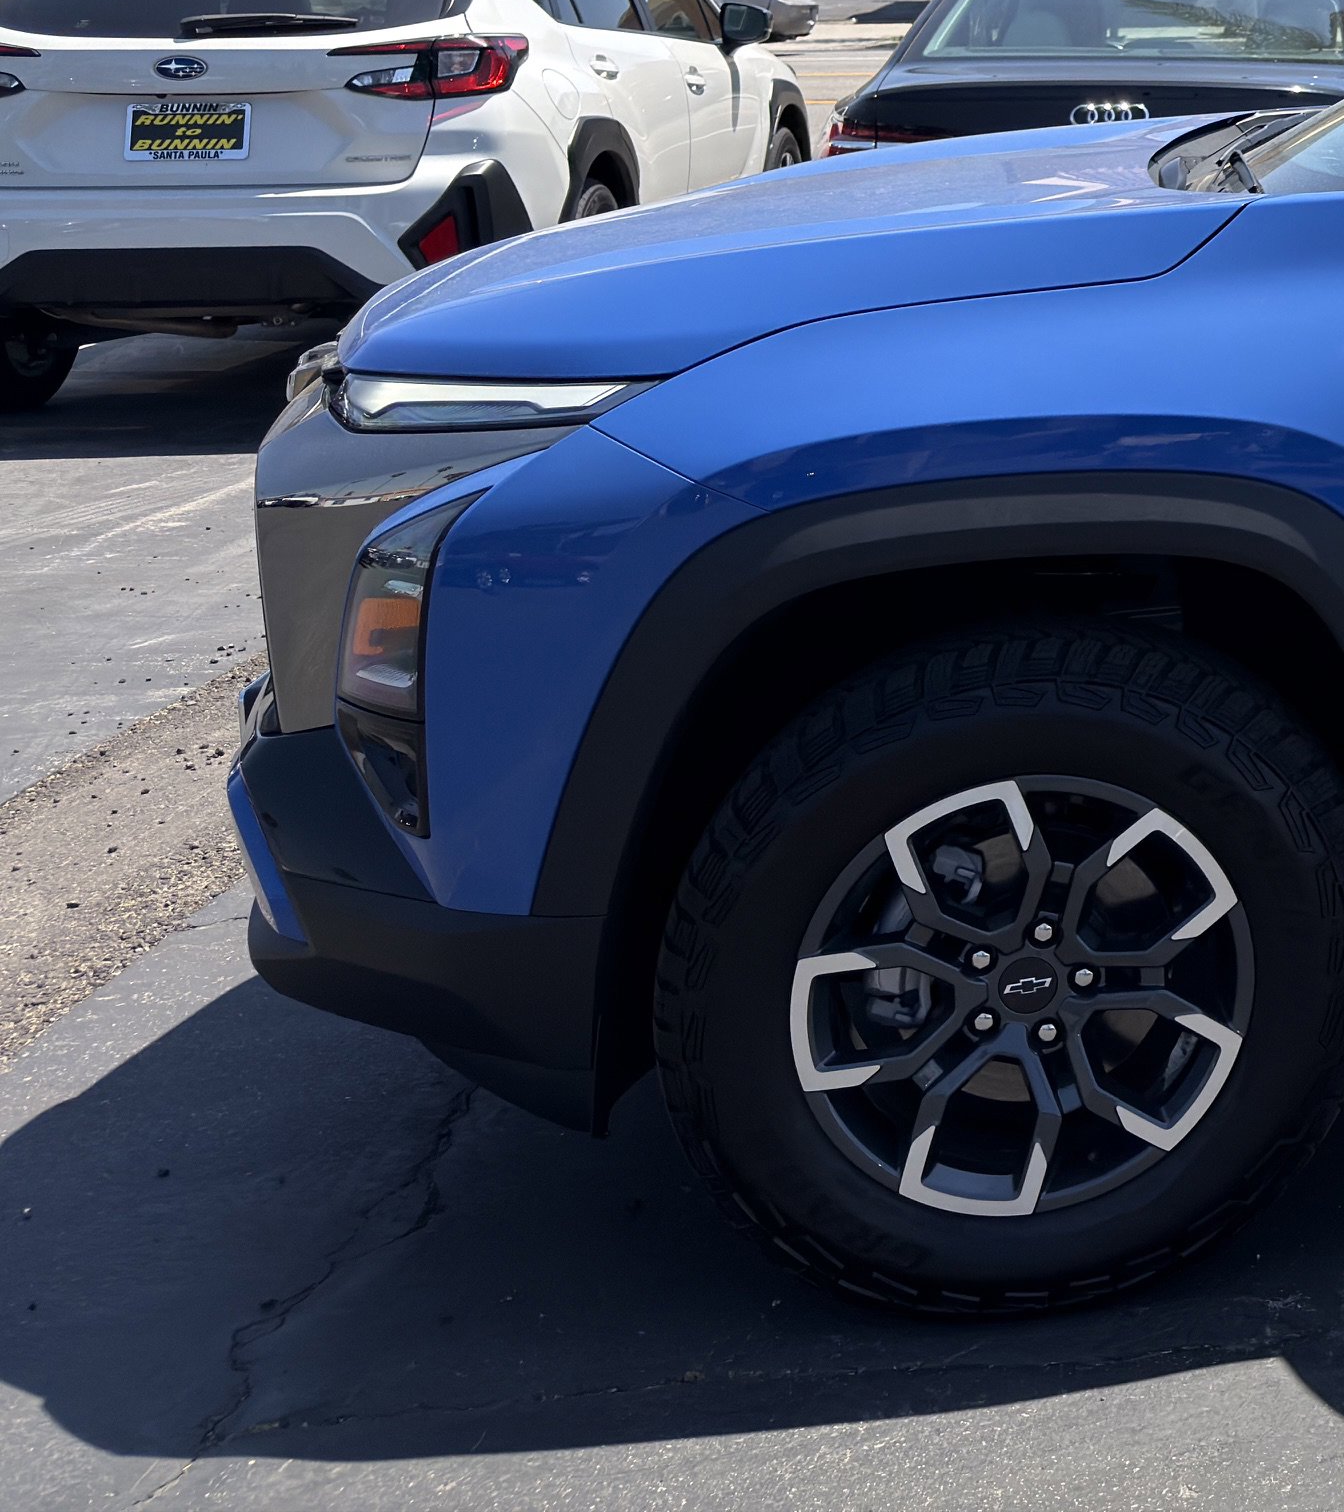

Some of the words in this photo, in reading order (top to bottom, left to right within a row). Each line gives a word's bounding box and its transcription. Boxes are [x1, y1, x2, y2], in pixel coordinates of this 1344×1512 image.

[160, 103, 219, 113] BUNNIN
[135, 114, 243, 125] RUNNIN'
[175, 126, 202, 136] to
[132, 138, 237, 150] BUNNIN
